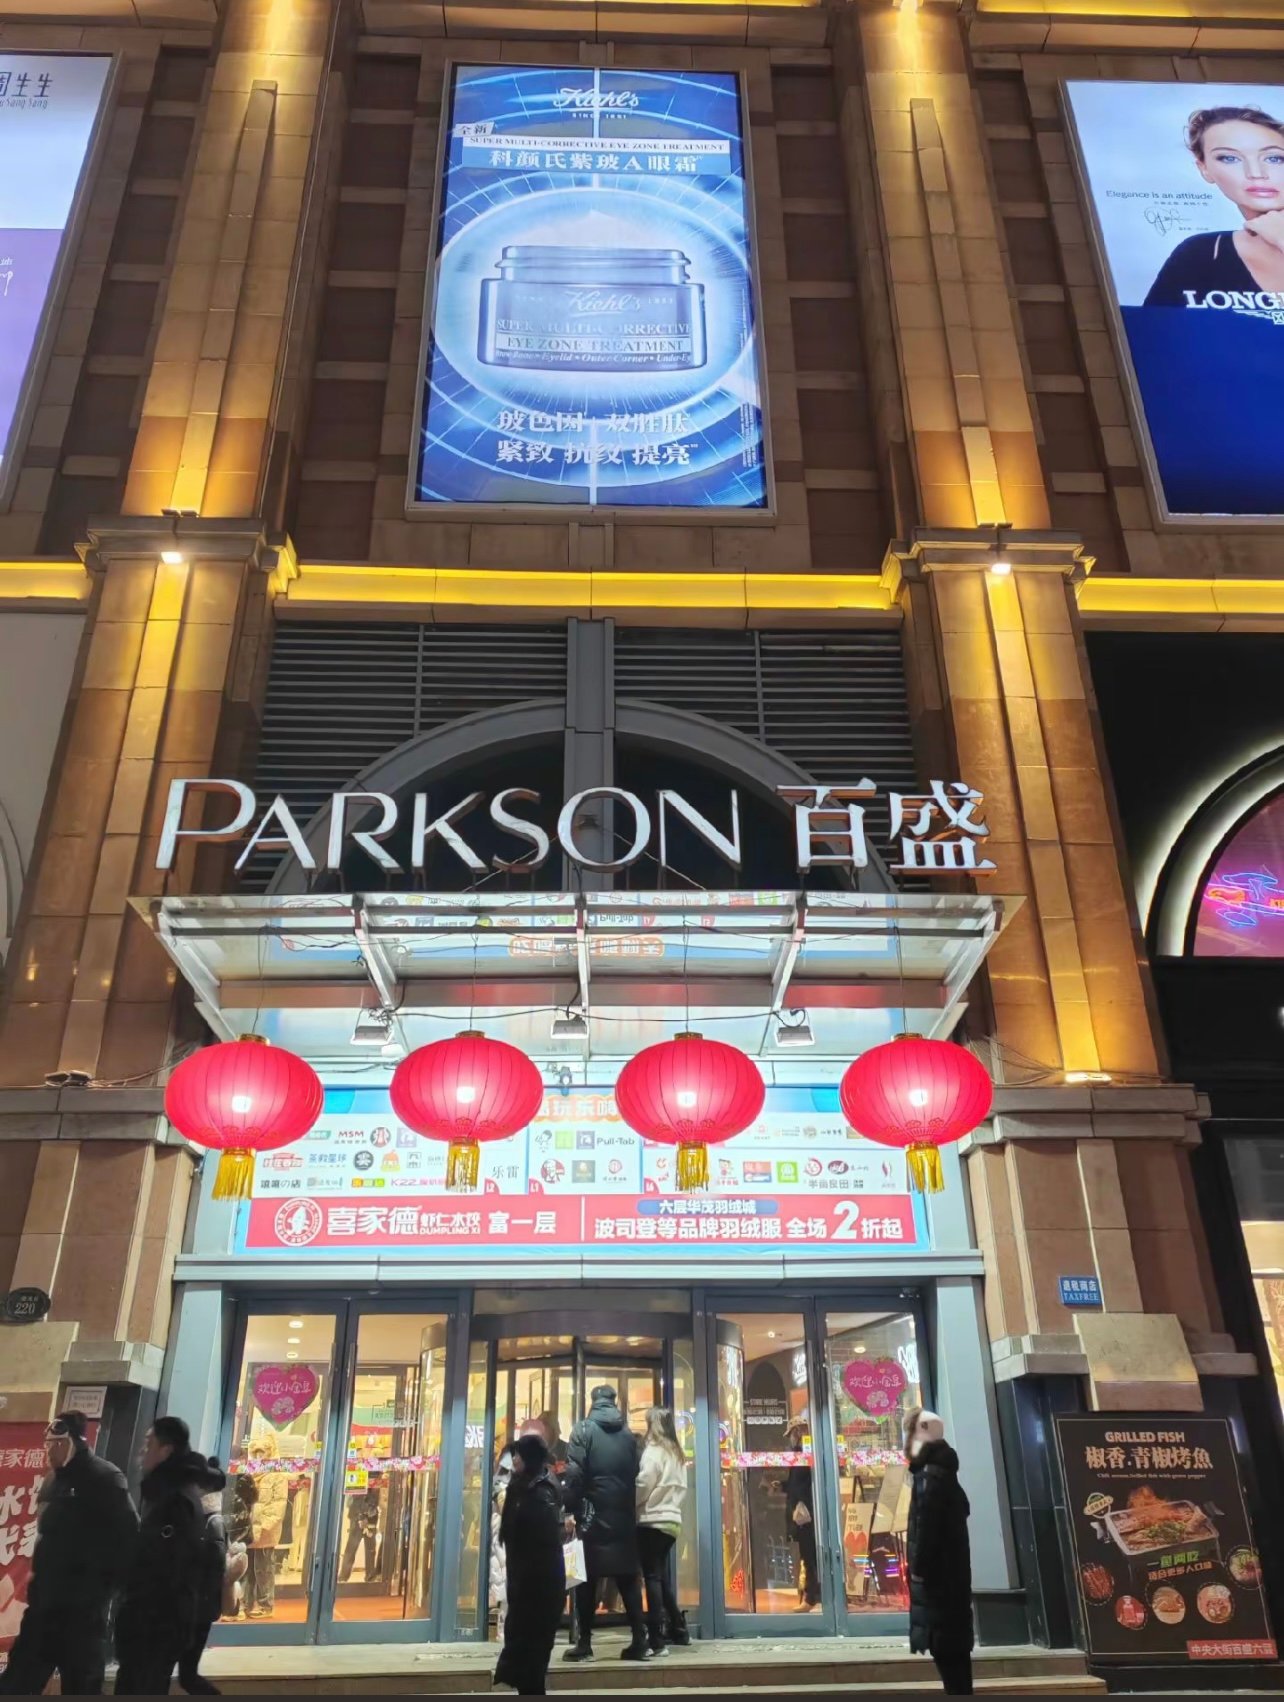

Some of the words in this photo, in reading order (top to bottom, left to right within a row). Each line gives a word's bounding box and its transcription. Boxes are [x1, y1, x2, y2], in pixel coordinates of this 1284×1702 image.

[470, 136, 502, 145] SUPER
[610, 141, 630, 149] EYE
[663, 143, 725, 152] TREATMENT
[1105, 190, 1150, 200] Elegance
[1152, 191, 1160, 199] is
[1176, 192, 1213, 200] attitude
[507, 336, 533, 348] EYE
[537, 338, 581, 351] ZONE
[591, 340, 684, 352] TREATMENT
[496, 440, 555, 464] 紧致
[564, 443, 623, 465] 抗纹
[633, 443, 690, 466] 提亮
[155, 778, 742, 874] PARKSON
[776, 777, 998, 875] 百盛
[338, 1130, 364, 1138] MSM
[596, 1137, 635, 1146] Pull-Tab
[327, 1206, 422, 1236] 喜家德
[594, 1216, 782, 1240] 波司登等品牌羽绒服
[1105, 1431, 1156, 1443] GRILLED
[1158, 1432, 1185, 1443] FISH
